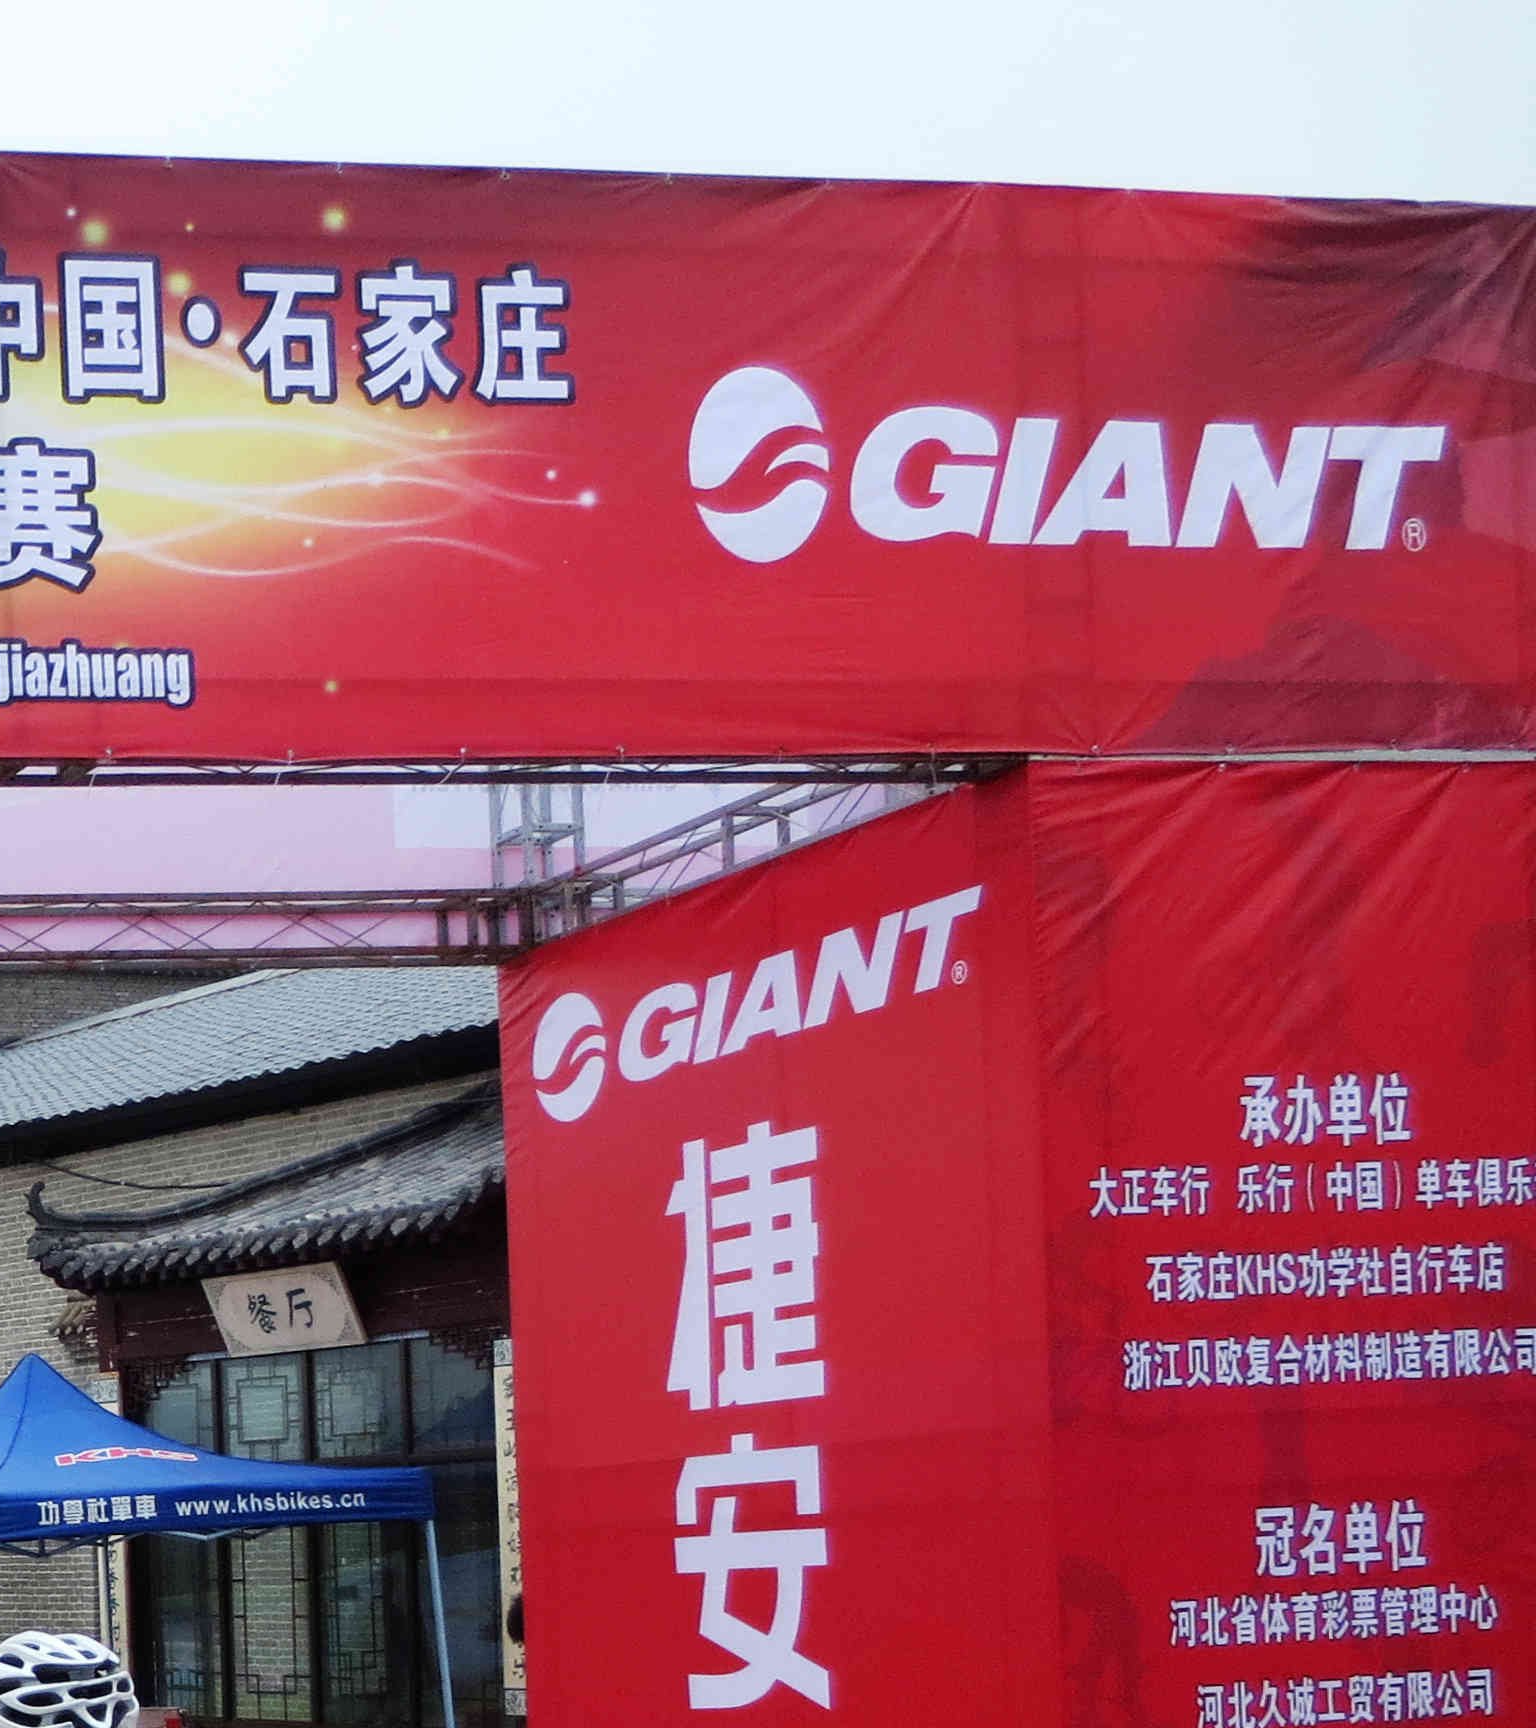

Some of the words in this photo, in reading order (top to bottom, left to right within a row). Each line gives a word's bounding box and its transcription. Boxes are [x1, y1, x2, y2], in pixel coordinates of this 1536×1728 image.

[850, 405, 1446, 551] GIANT
[617, 885, 983, 1081] GIANT
[1239, 1072, 1413, 1148] 承办单位
[1088, 1165, 1210, 1218] 大正车行
[1236, 1157, 1536, 1214] 乐行（中国）单车俱乐
[1145, 1242, 1505, 1303] 石家庄KHS功学社自行车店
[247, 1287, 315, 1335] 餐厅
[1122, 1326, 1536, 1391] 浙江贝欧复合材料制造有限公司
[174, 1490, 367, 1518] www.khsbikes.cn
[1255, 1498, 1427, 1577] 冠名单位
[1169, 1583, 1499, 1648] 河北省体育彩票管理中心
